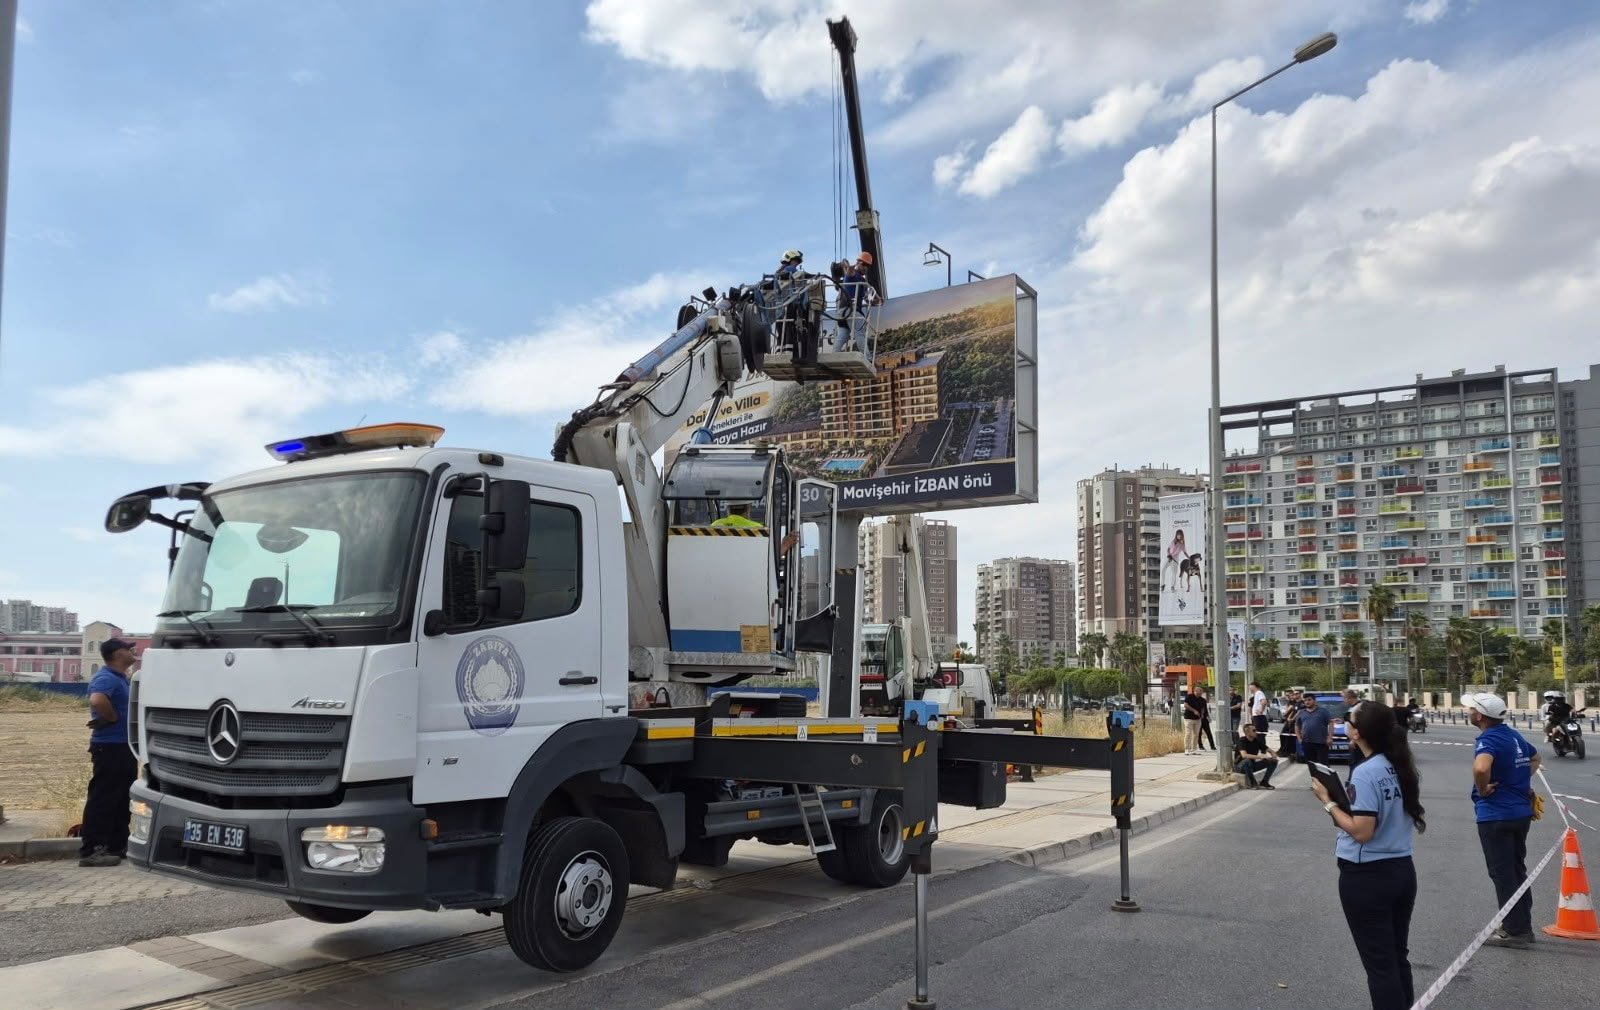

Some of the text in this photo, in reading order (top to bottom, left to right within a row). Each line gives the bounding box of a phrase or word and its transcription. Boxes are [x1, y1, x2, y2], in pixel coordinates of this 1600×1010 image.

[687, 396, 761, 427] Dai ve Villa
[713, 414, 743, 430] enekleri
[740, 422, 768, 438] Hazır
[801, 487, 819, 501] 30
[843, 481, 911, 500] Mavişehir
[914, 476, 959, 493] İZBAN
[962, 473, 992, 488] önü
[473, 640, 510, 657] ZABITA
[190, 823, 244, 847] 35 EN 538
